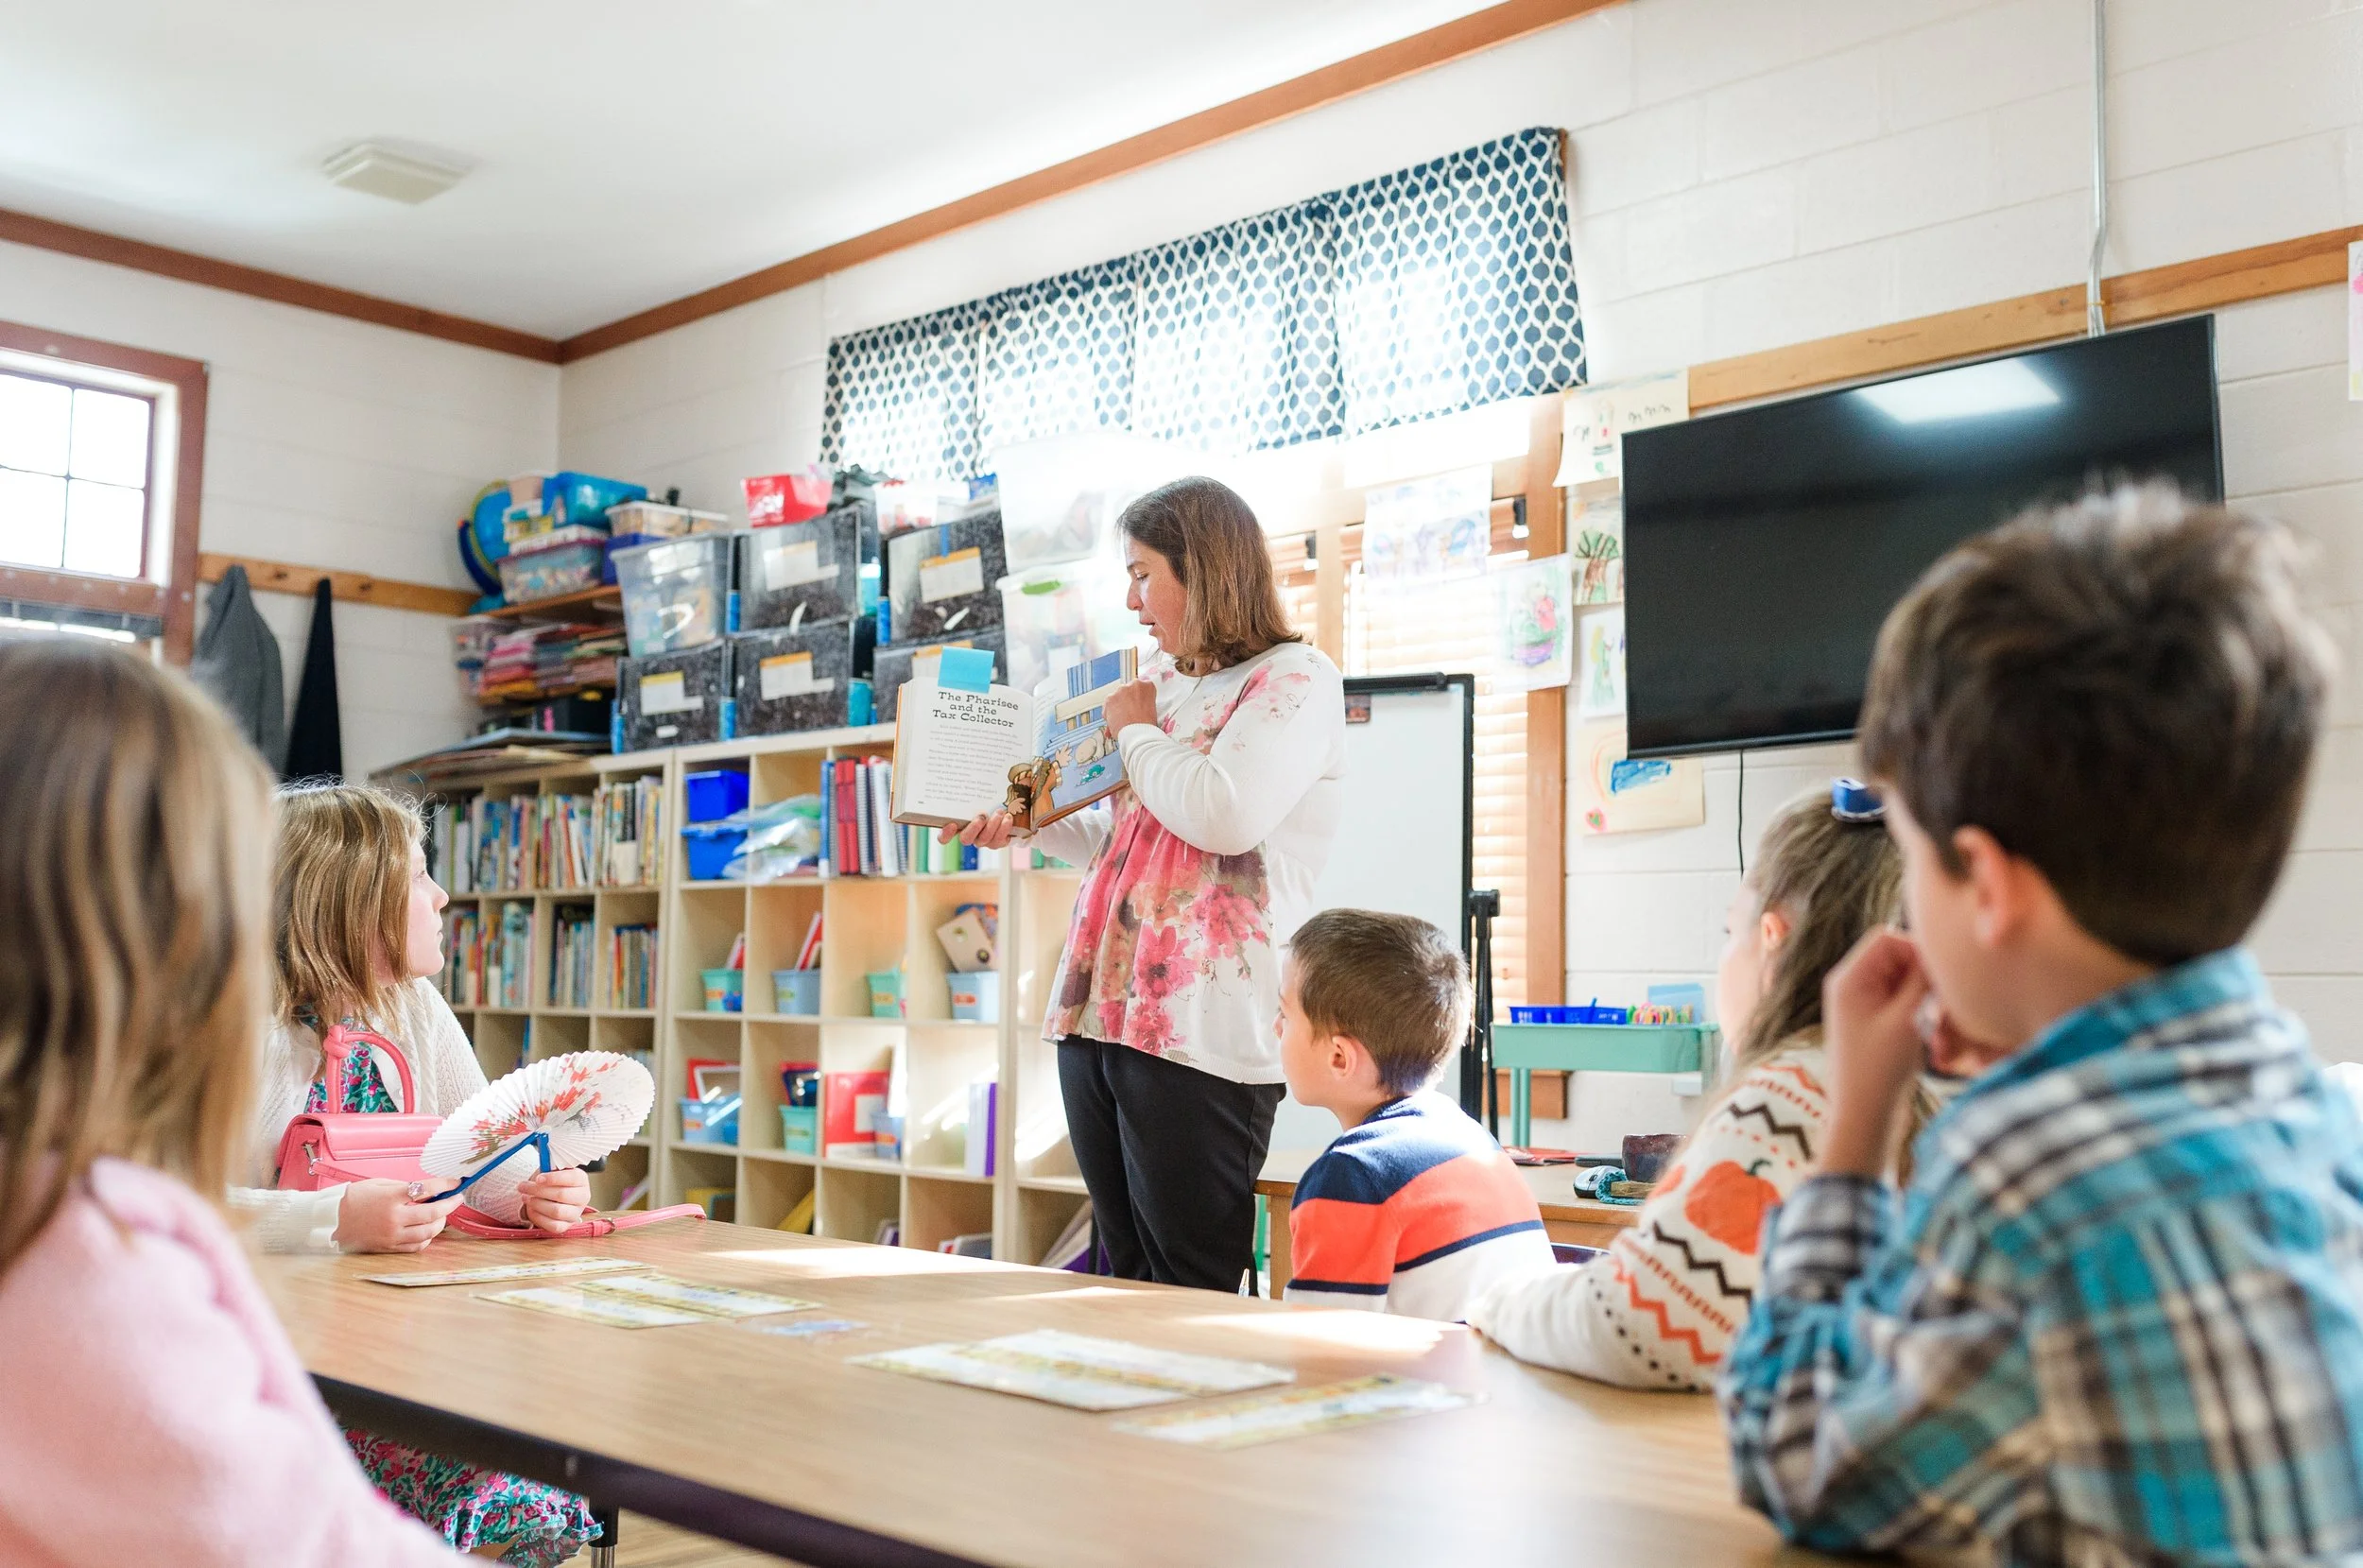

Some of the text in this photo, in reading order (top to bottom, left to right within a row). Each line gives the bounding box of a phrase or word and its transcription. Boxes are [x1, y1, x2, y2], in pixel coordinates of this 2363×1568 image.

[939, 691, 1019, 711] The Pharisee
[949, 703, 997, 715] and the
[932, 709, 1014, 728] Tax Collector
